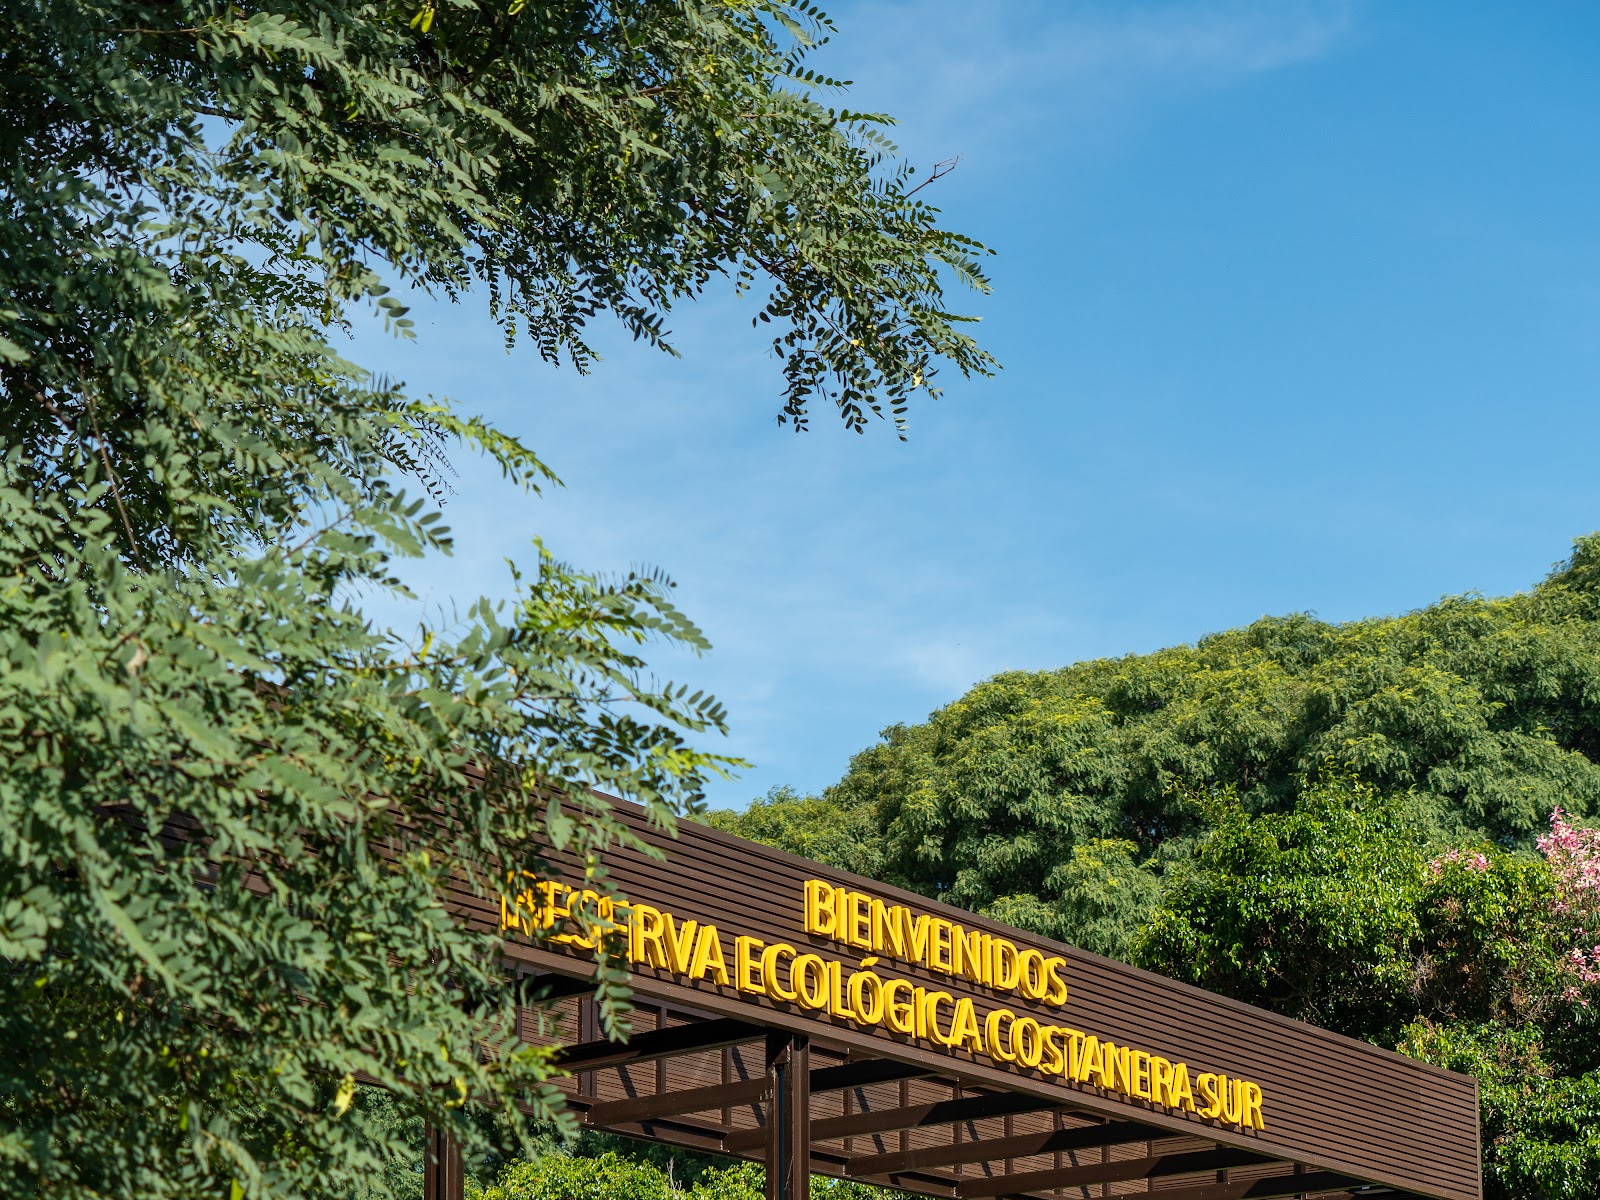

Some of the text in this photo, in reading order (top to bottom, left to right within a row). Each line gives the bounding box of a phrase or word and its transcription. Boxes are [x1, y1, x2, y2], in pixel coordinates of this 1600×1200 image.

[804, 879, 1068, 1006] BIENVENIDOS
[735, 935, 983, 1053] ECOLÓGICA
[985, 1008, 1196, 1113] COSTANERA
[1196, 1072, 1265, 1130] SUR
